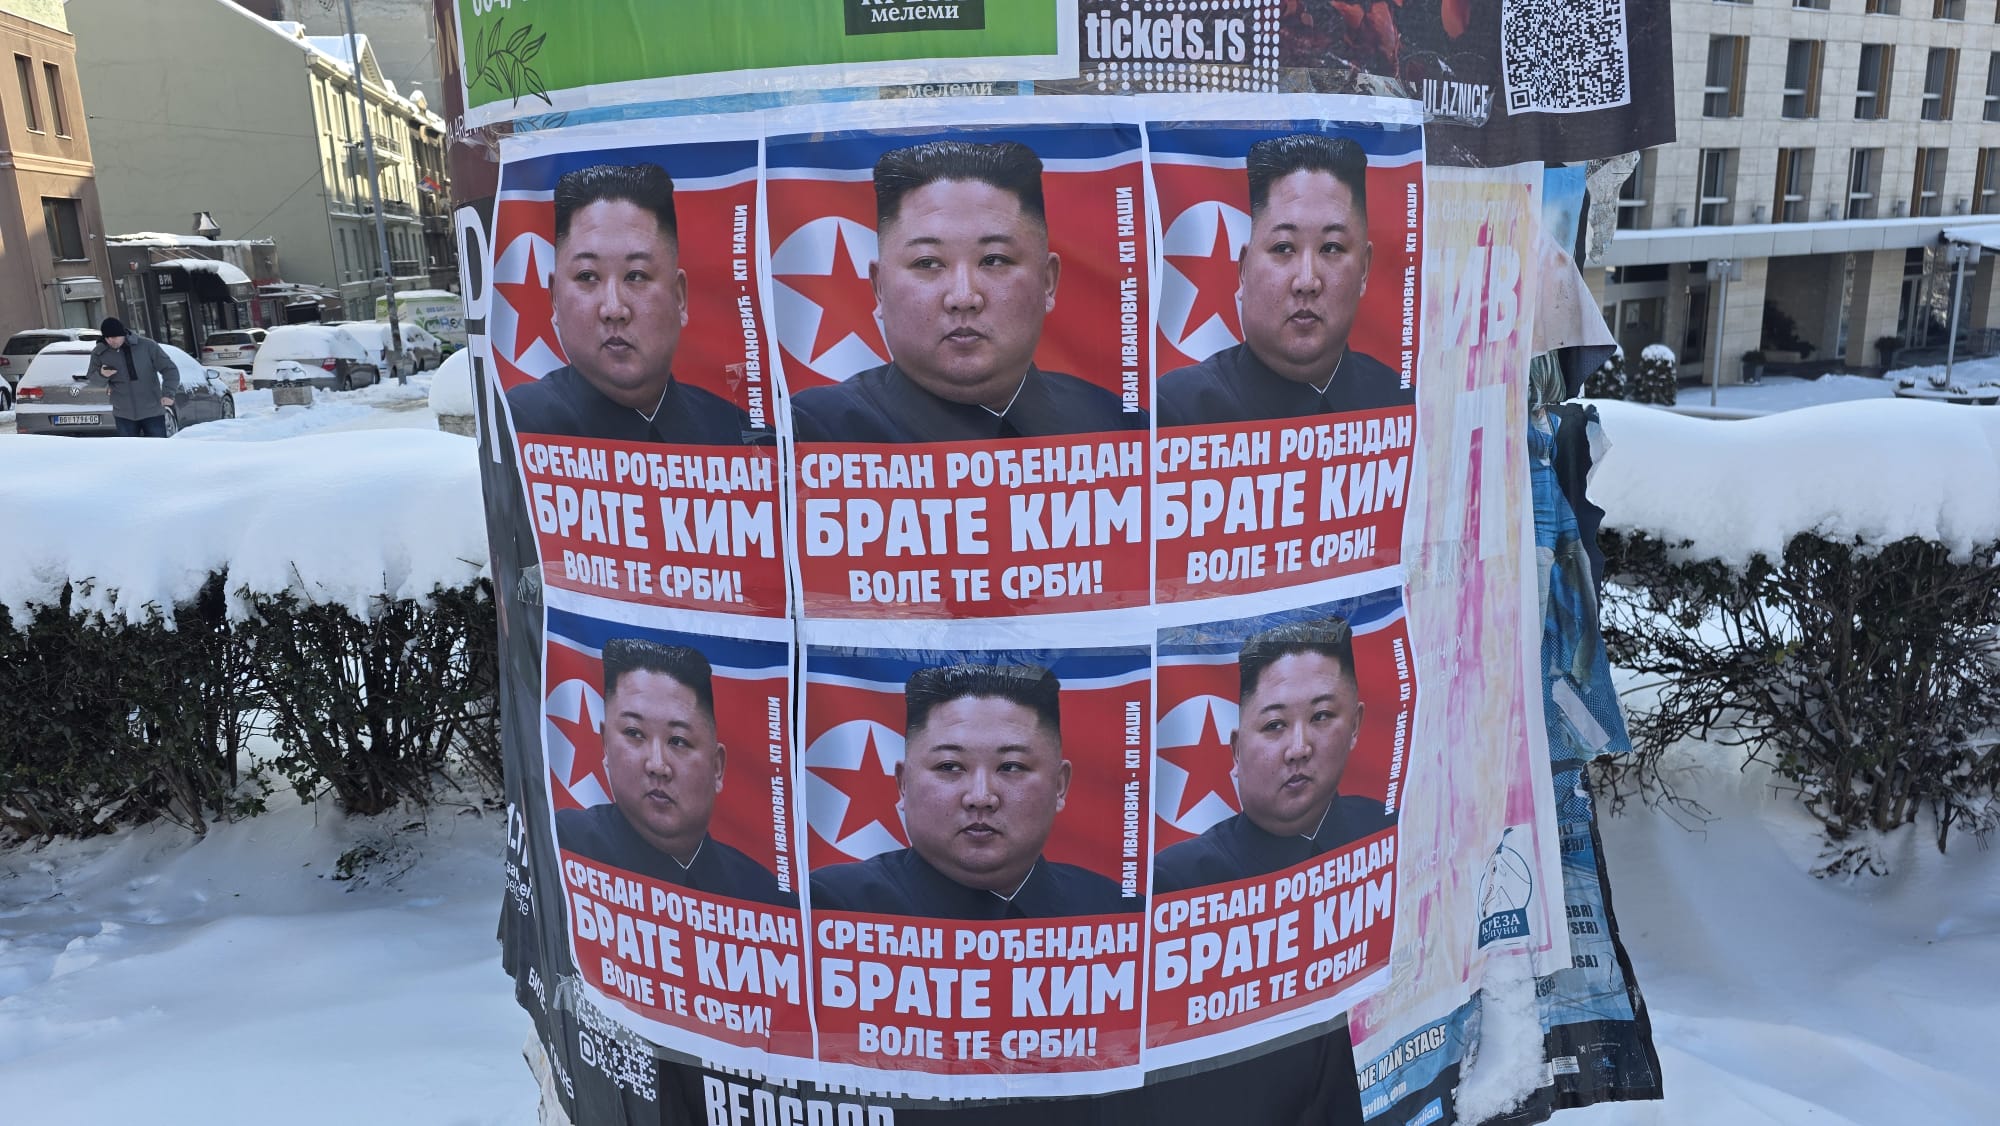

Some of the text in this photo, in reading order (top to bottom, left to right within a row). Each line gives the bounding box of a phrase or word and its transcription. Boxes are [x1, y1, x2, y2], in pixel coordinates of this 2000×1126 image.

[871, 5, 959, 22] мелеми
[1085, 10, 1245, 62] tickets.rs
[906, 82, 992, 98] мелеми
[1423, 79, 1488, 118] ULAZNICE
[733, 204, 747, 254] НАШИ
[1116, 187, 1134, 236] НАШИ
[1407, 183, 1417, 228] НАШИ
[1119, 241, 1136, 263] КП
[1406, 233, 1416, 252] КП
[733, 259, 747, 281] КП
[1121, 277, 1138, 366] ИВАНОВИЋ
[1402, 266, 1415, 346] ИВАНОВИЋ
[738, 295, 761, 381] ИВАНОВИЋ
[1122, 371, 1139, 413] ИВАН
[1400, 350, 1413, 389] ИВАН
[748, 386, 765, 429] ИВАН
[524, 443, 772, 494] СРЕЋАН РОЂЕНДАН
[801, 441, 1142, 489] СРЕЋАН РОЂЕНДАН
[1156, 415, 1412, 473] СРЕЋАН РОЂЕНДАН
[532, 482, 775, 558] БРАТЕ КИМ
[806, 486, 1142, 557] БРАТЕ КИМ
[1156, 456, 1408, 540] БРАТЕ КИМ
[563, 550, 743, 603] ВОЛЕ ТЕ СРБИ!
[1187, 526, 1376, 584] ВОЛЕ ТЕ СРБИ!
[849, 560, 1103, 603] ВОЛЕ ТЕ СРБИ!
[1393, 638, 1408, 680] НАШИ
[1400, 682, 1410, 701] КП
[768, 696, 781, 740] НАШИ
[1125, 702, 1141, 745] НАШИ
[770, 744, 782, 764] КП
[1125, 750, 1140, 768] КП
[1390, 711, 1408, 780] ИВАНОВИЋ
[771, 776, 787, 852] ИВАНОВИЋ
[1123, 781, 1140, 857] ИВАНОВИЋ
[1385, 782, 1398, 816] ИВАН
[776, 855, 791, 893] ИВАН
[1122, 861, 1137, 898] ИВАН
[1154, 884, 1266, 933] СРЕЋАН
[1275, 835, 1394, 909] РОЂЕНДАН
[565, 859, 644, 912] СРЕЋАН
[651, 886, 798, 947] РОЂЕНДАН
[572, 892, 800, 1005] БРАТЕ КИМ
[818, 919, 1138, 962] СРЕЋАН РОЂЕНДАН
[1154, 910, 1299, 992] БРАТЕ
[1313, 871, 1392, 950] КИМ
[601, 956, 772, 1038] ВОЛЕ ТЕ СРБИ!
[821, 957, 1136, 1019] БРАТЕ КИМ
[1188, 980, 1260, 1026] ВОЛЕ
[1269, 970, 1297, 1002] ТЕ
[1304, 940, 1368, 991] СРБИ!
[858, 1022, 1097, 1060] ВОЛЕ ТЕ СРБИ!
[1378, 1044, 1403, 1082] MAN
[1405, 1024, 1446, 1062] STAGE
